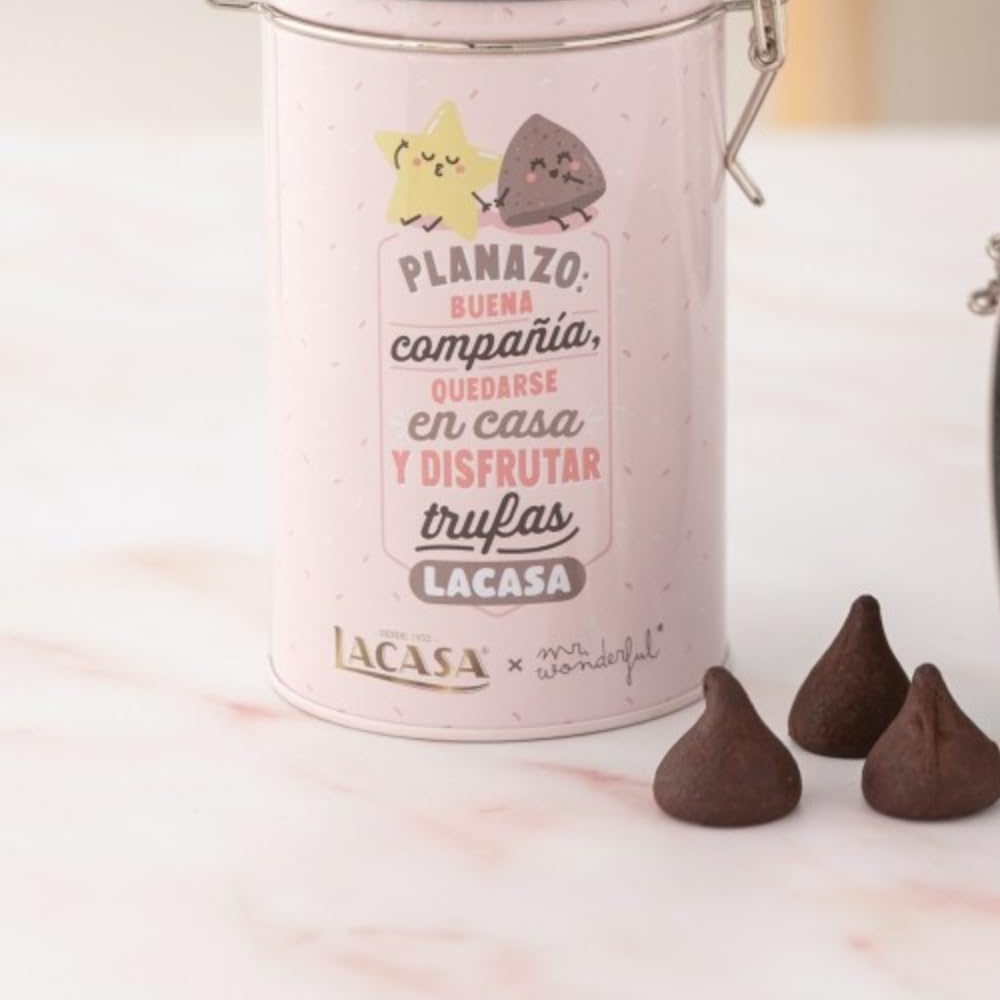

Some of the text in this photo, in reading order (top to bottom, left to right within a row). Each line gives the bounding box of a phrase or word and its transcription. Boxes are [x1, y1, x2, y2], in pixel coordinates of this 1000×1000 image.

[398, 243, 589, 293] PLANAZO:
[450, 289, 533, 319] BUENA
[390, 311, 601, 371] compañía,
[431, 369, 559, 404] QUEDARSE
[407, 408, 585, 441] en casa
[391, 447, 601, 489] Y DISFRUTAR
[420, 491, 574, 555] trufas
[422, 563, 572, 599] LACASA
